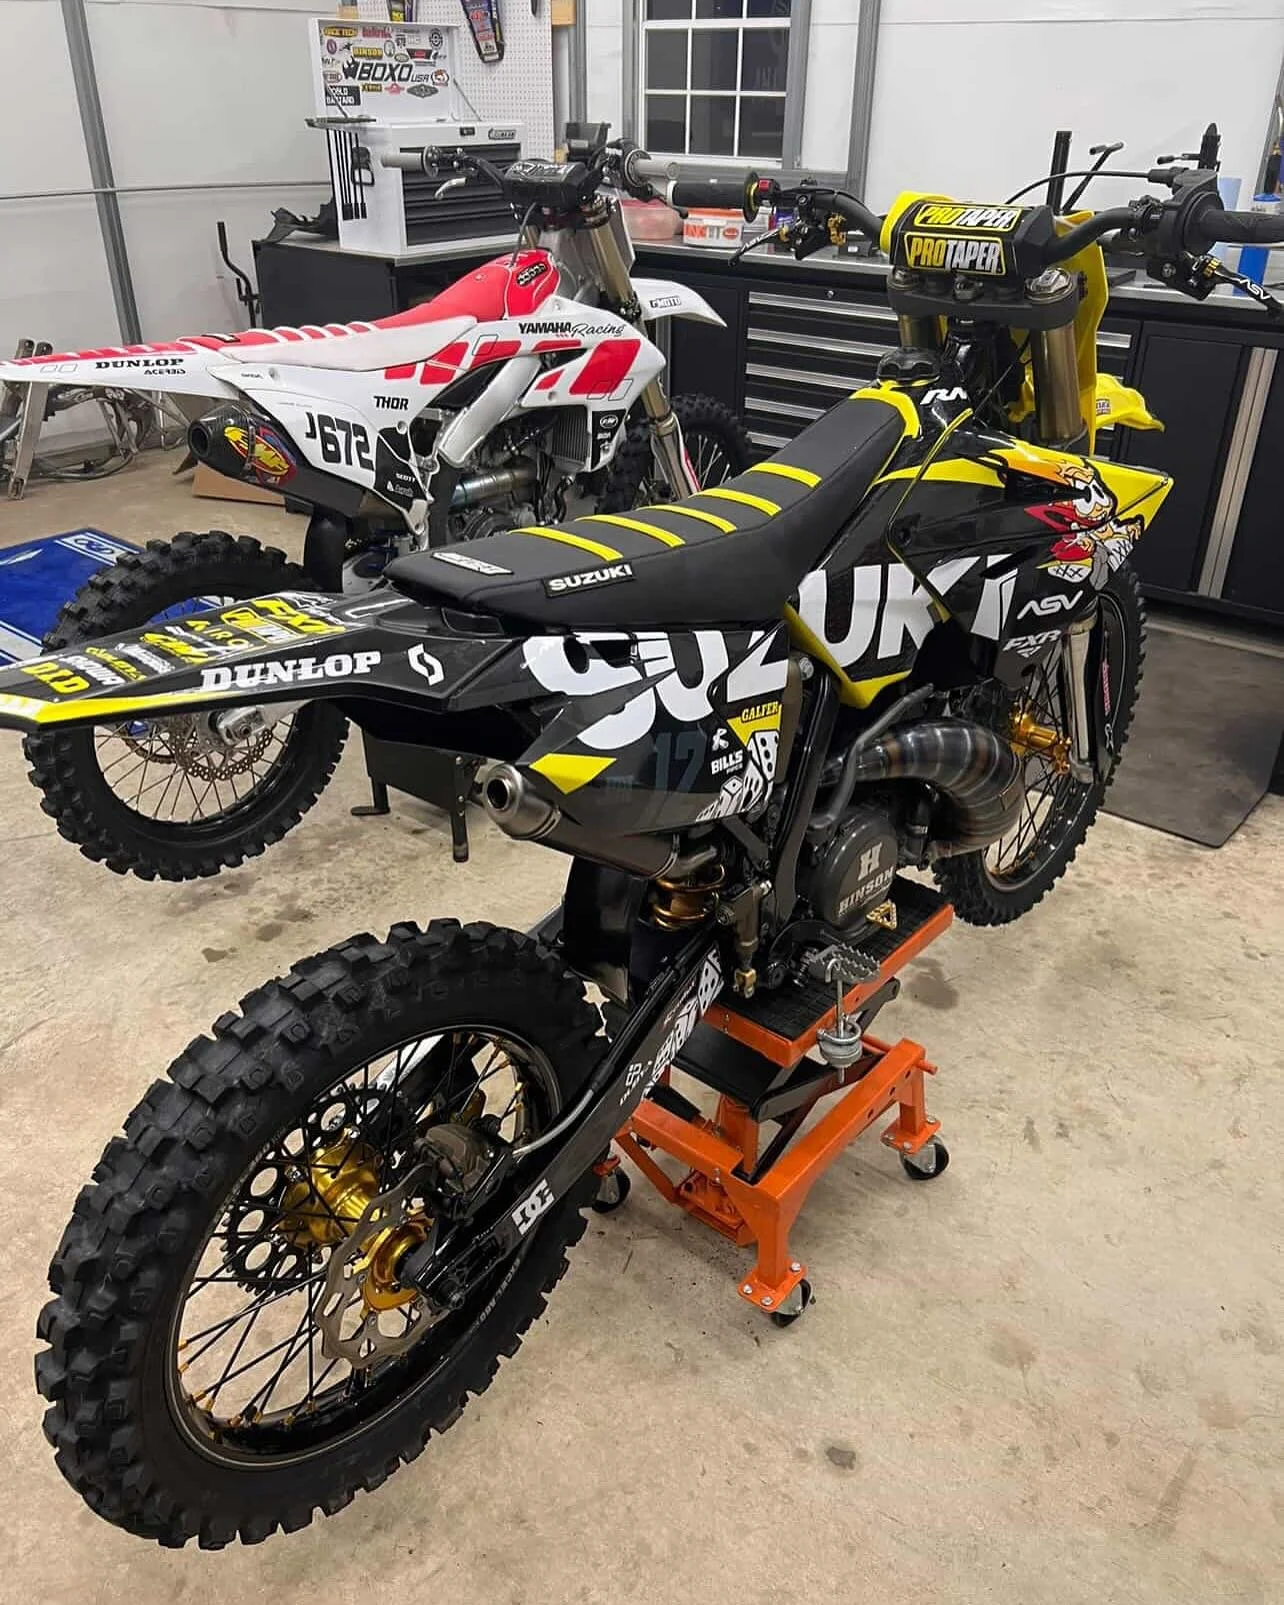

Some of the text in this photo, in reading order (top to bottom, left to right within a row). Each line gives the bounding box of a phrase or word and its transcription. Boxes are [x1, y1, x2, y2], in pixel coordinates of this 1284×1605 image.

[358, 62, 413, 82] BOXO
[411, 74, 429, 82] USA
[919, 206, 1016, 227] PROTAPER
[910, 237, 999, 273] PROTAPER
[519, 322, 624, 338] YAMAHA Racing
[95, 358, 184, 369] DUNLOP
[372, 396, 408, 412] THOR
[548, 563, 632, 591] SUZUKI
[1016, 589, 1083, 620] ASV
[199, 651, 380, 692] DUNLOP
[741, 701, 778, 721] GALFER
[839, 866, 894, 916] HINSON
